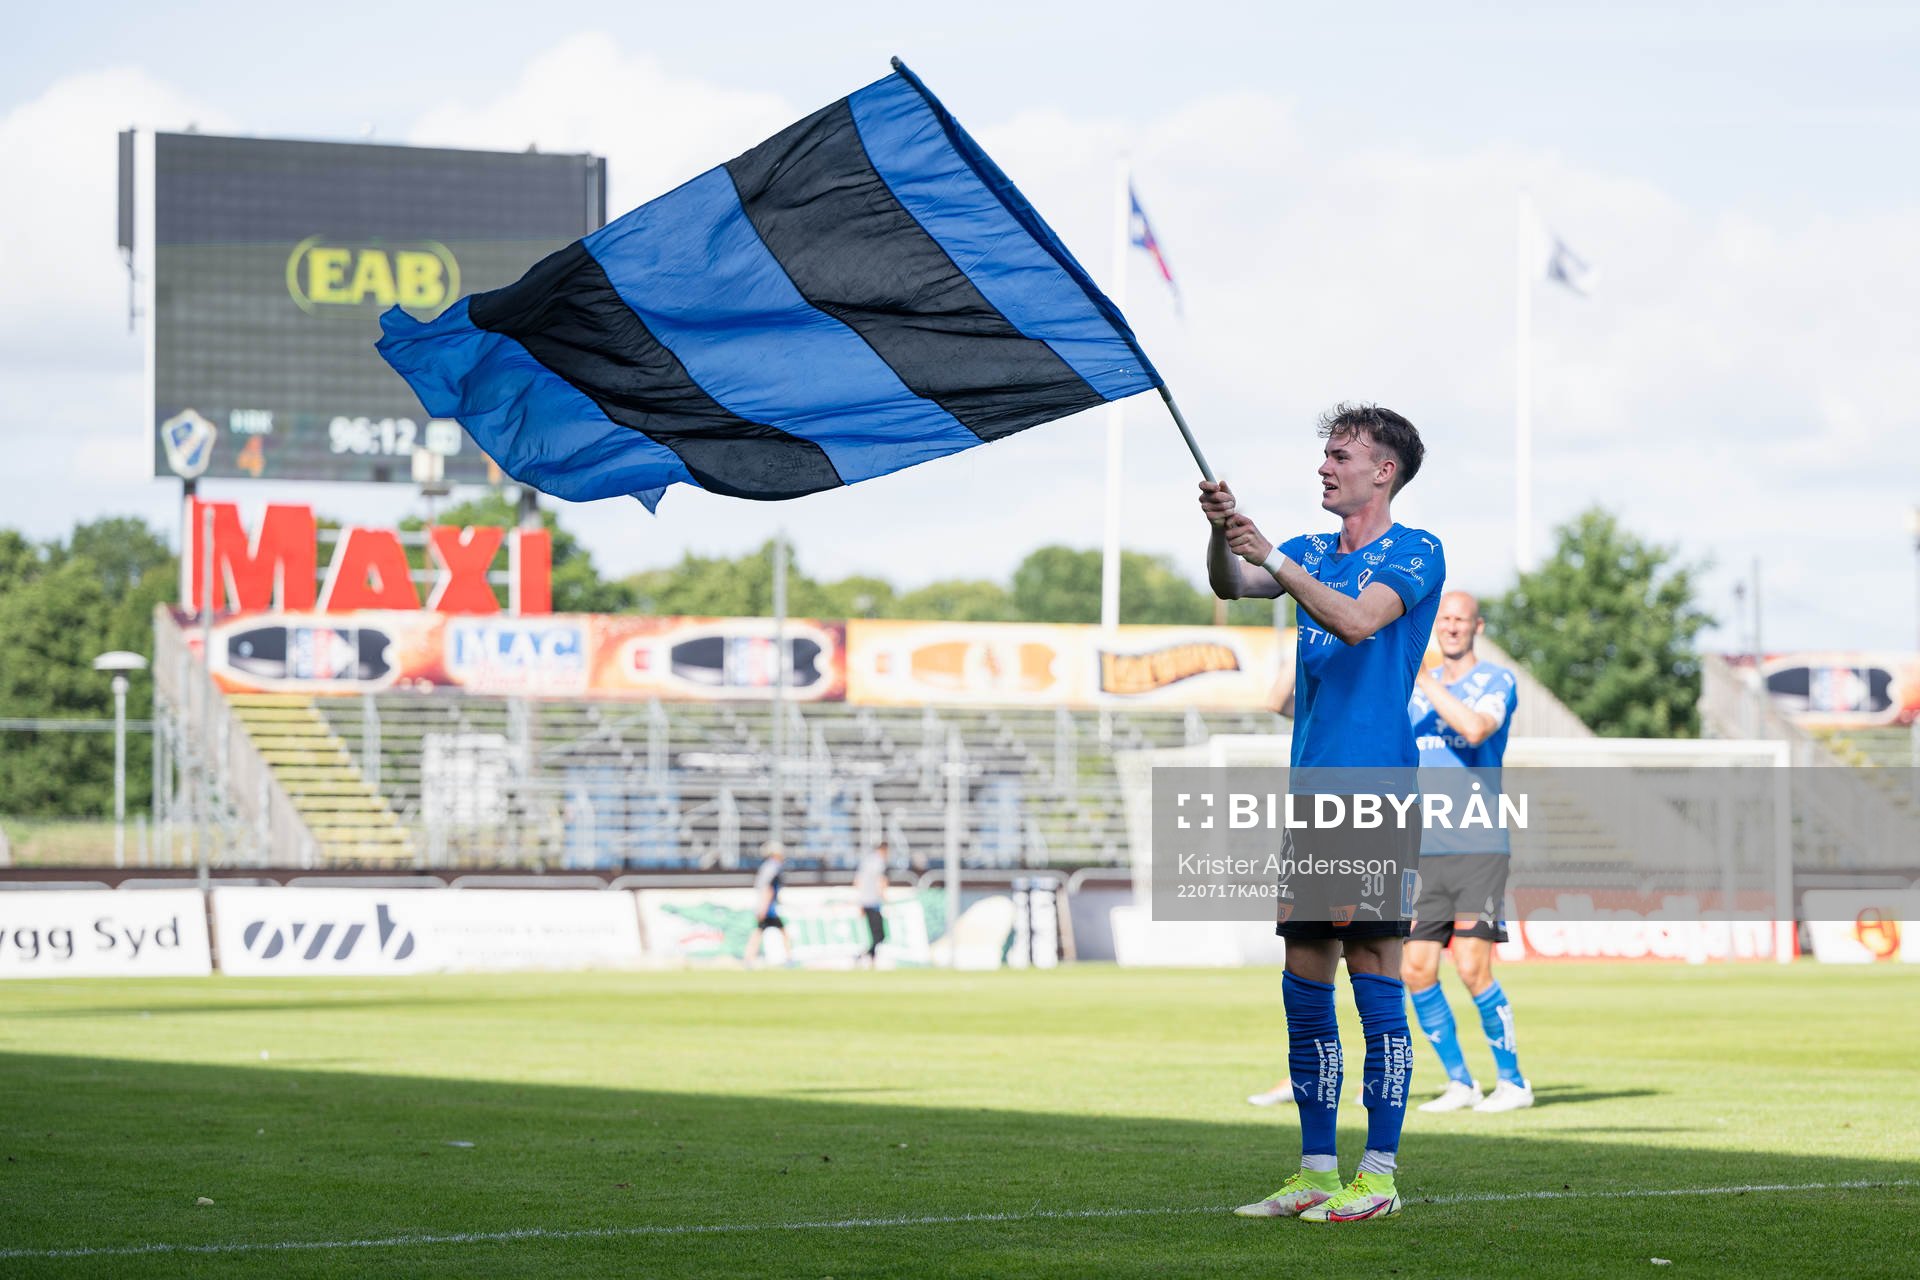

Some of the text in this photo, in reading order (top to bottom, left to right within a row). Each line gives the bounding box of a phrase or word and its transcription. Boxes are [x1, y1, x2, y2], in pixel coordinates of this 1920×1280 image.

[307, 247, 446, 309] EAB
[328, 416, 418, 455] 96:12
[184, 497, 553, 617] MAXI
[1361, 873, 1385, 897] 30
[93, 916, 182, 962] Syd
[1324, 1040, 1338, 1110] Transport
[1391, 1035, 1408, 1109] Transport
